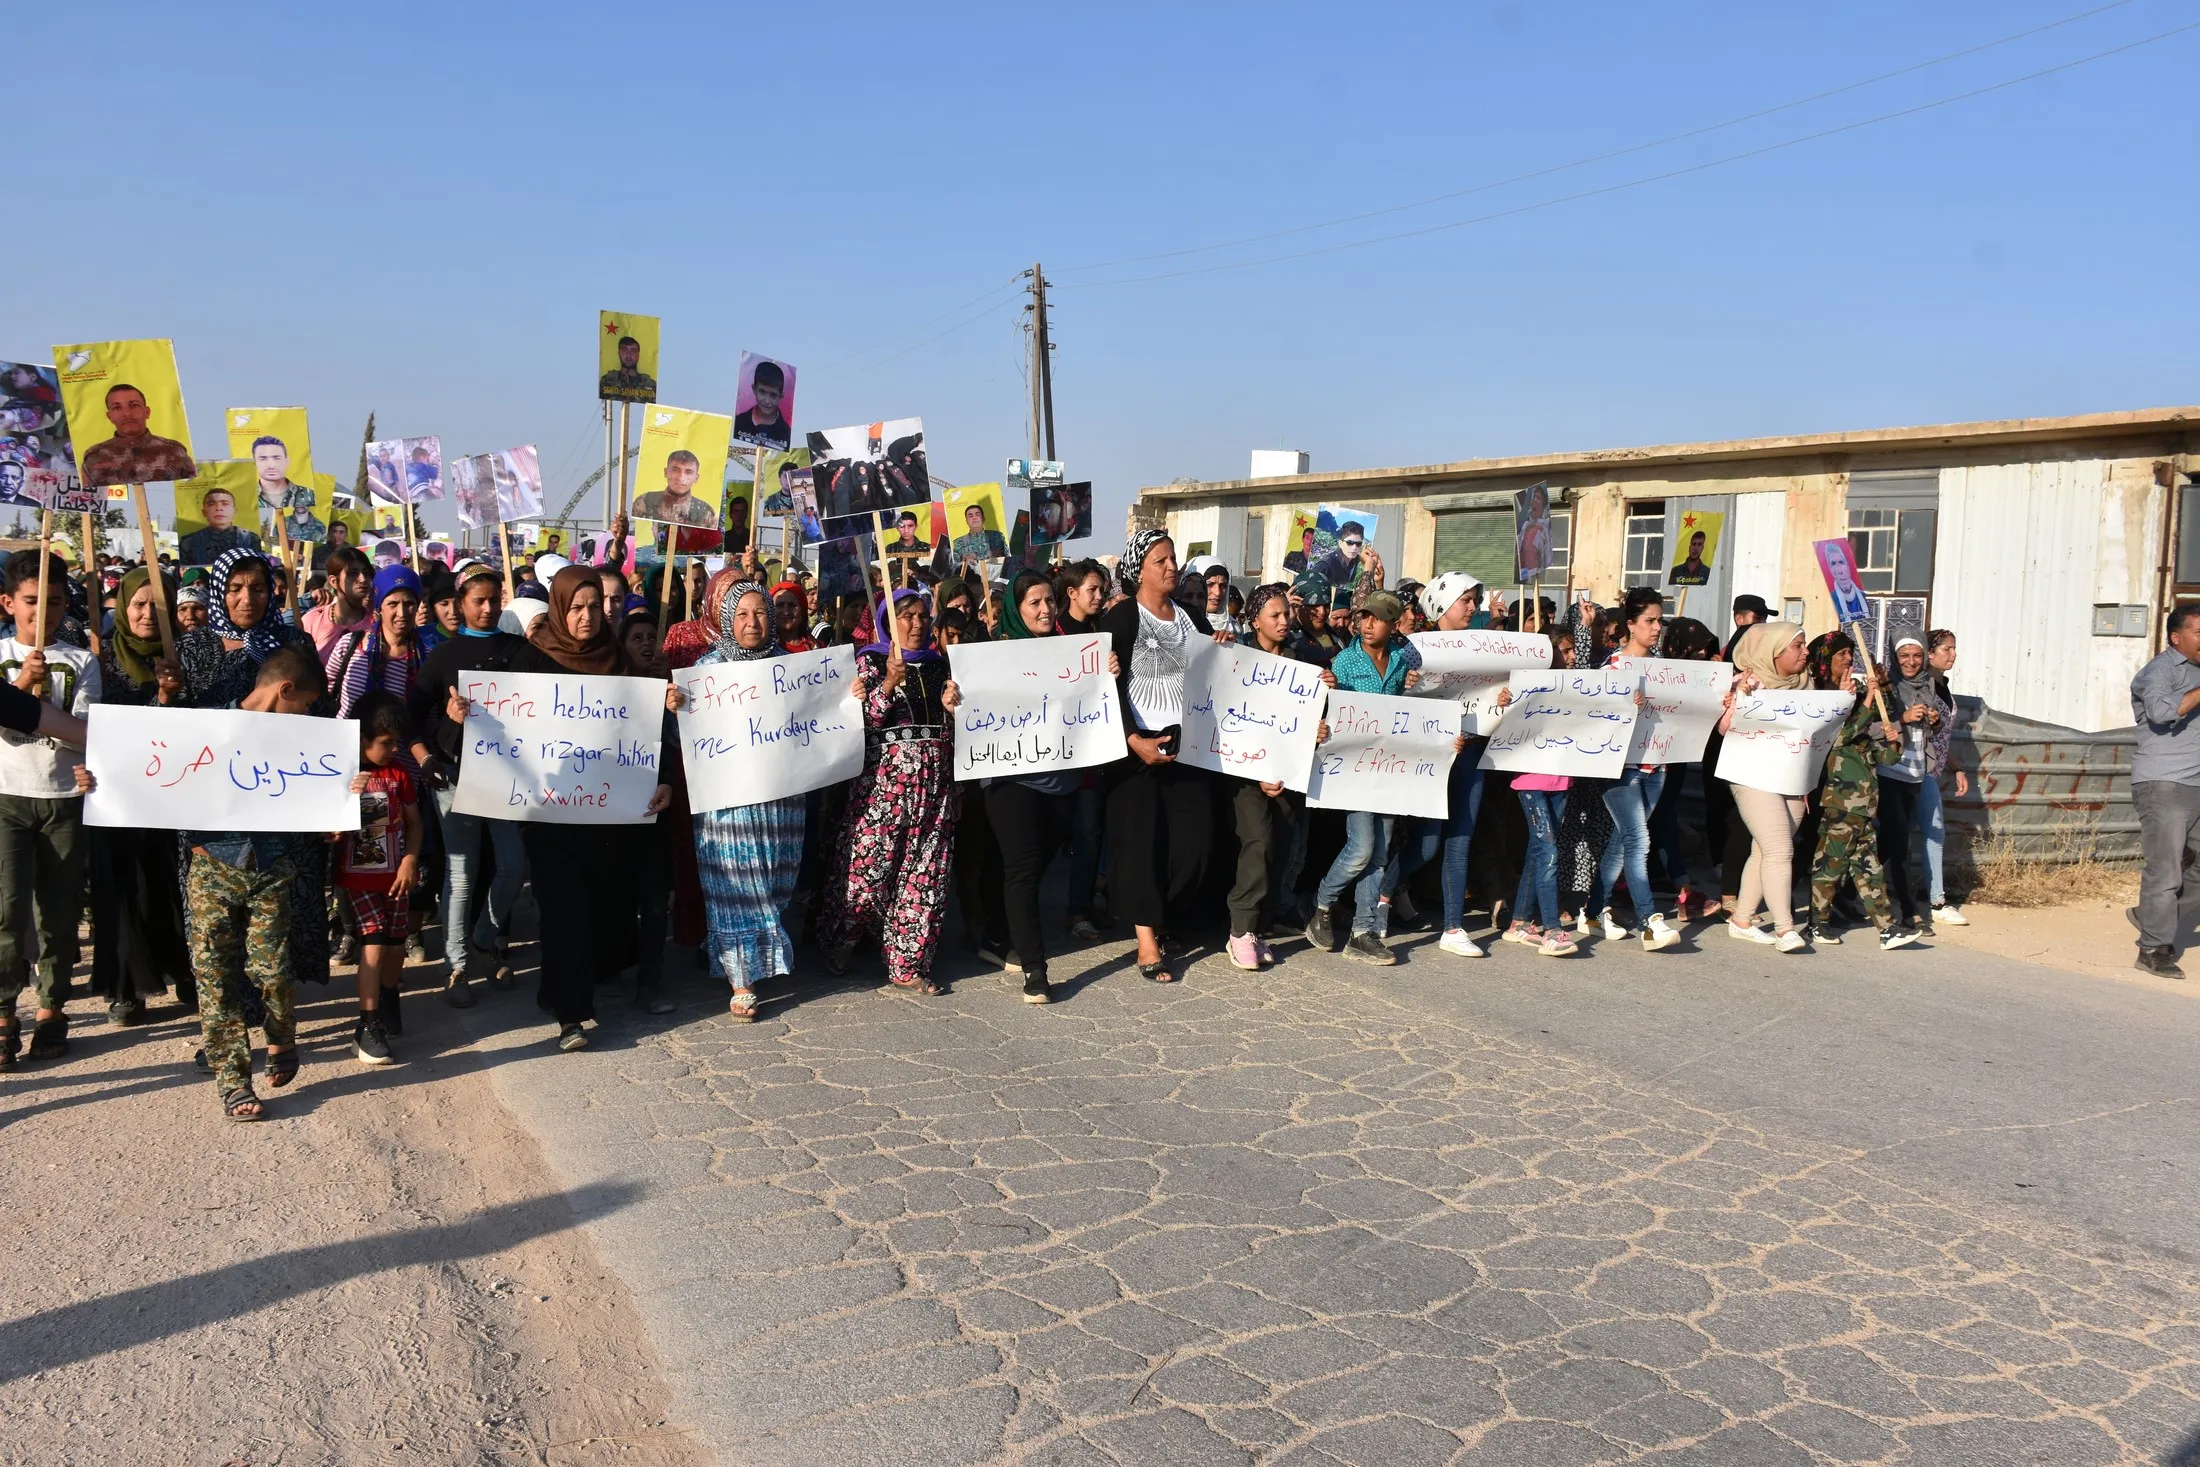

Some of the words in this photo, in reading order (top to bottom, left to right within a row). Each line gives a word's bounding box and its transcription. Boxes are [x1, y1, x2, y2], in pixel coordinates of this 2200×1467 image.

[1058, 639, 1100, 684] الكرد
[1526, 647, 1547, 659] me
[1510, 673, 1564, 705] العصر
[1572, 671, 1631, 697] مقاومة
[553, 682, 630, 720] hebûne
[1011, 692, 1049, 729] أرض
[1062, 691, 1109, 730] أصحاب
[1187, 685, 1214, 717] طمس
[1220, 701, 1277, 733] تستطيع
[1802, 701, 1849, 723] عفرين
[1279, 716, 1298, 734] لن
[1488, 728, 1531, 751] التاريخ
[541, 740, 613, 774] rizgar
[692, 736, 738, 760] me
[1025, 735, 1074, 764] فارحل
[1209, 726, 1267, 764] هويتنا
[1533, 734, 1574, 750] جبين
[145, 740, 214, 788] حرة
[229, 750, 342, 797] عفرين
[1415, 758, 1435, 777] im
[508, 777, 532, 807] bi
